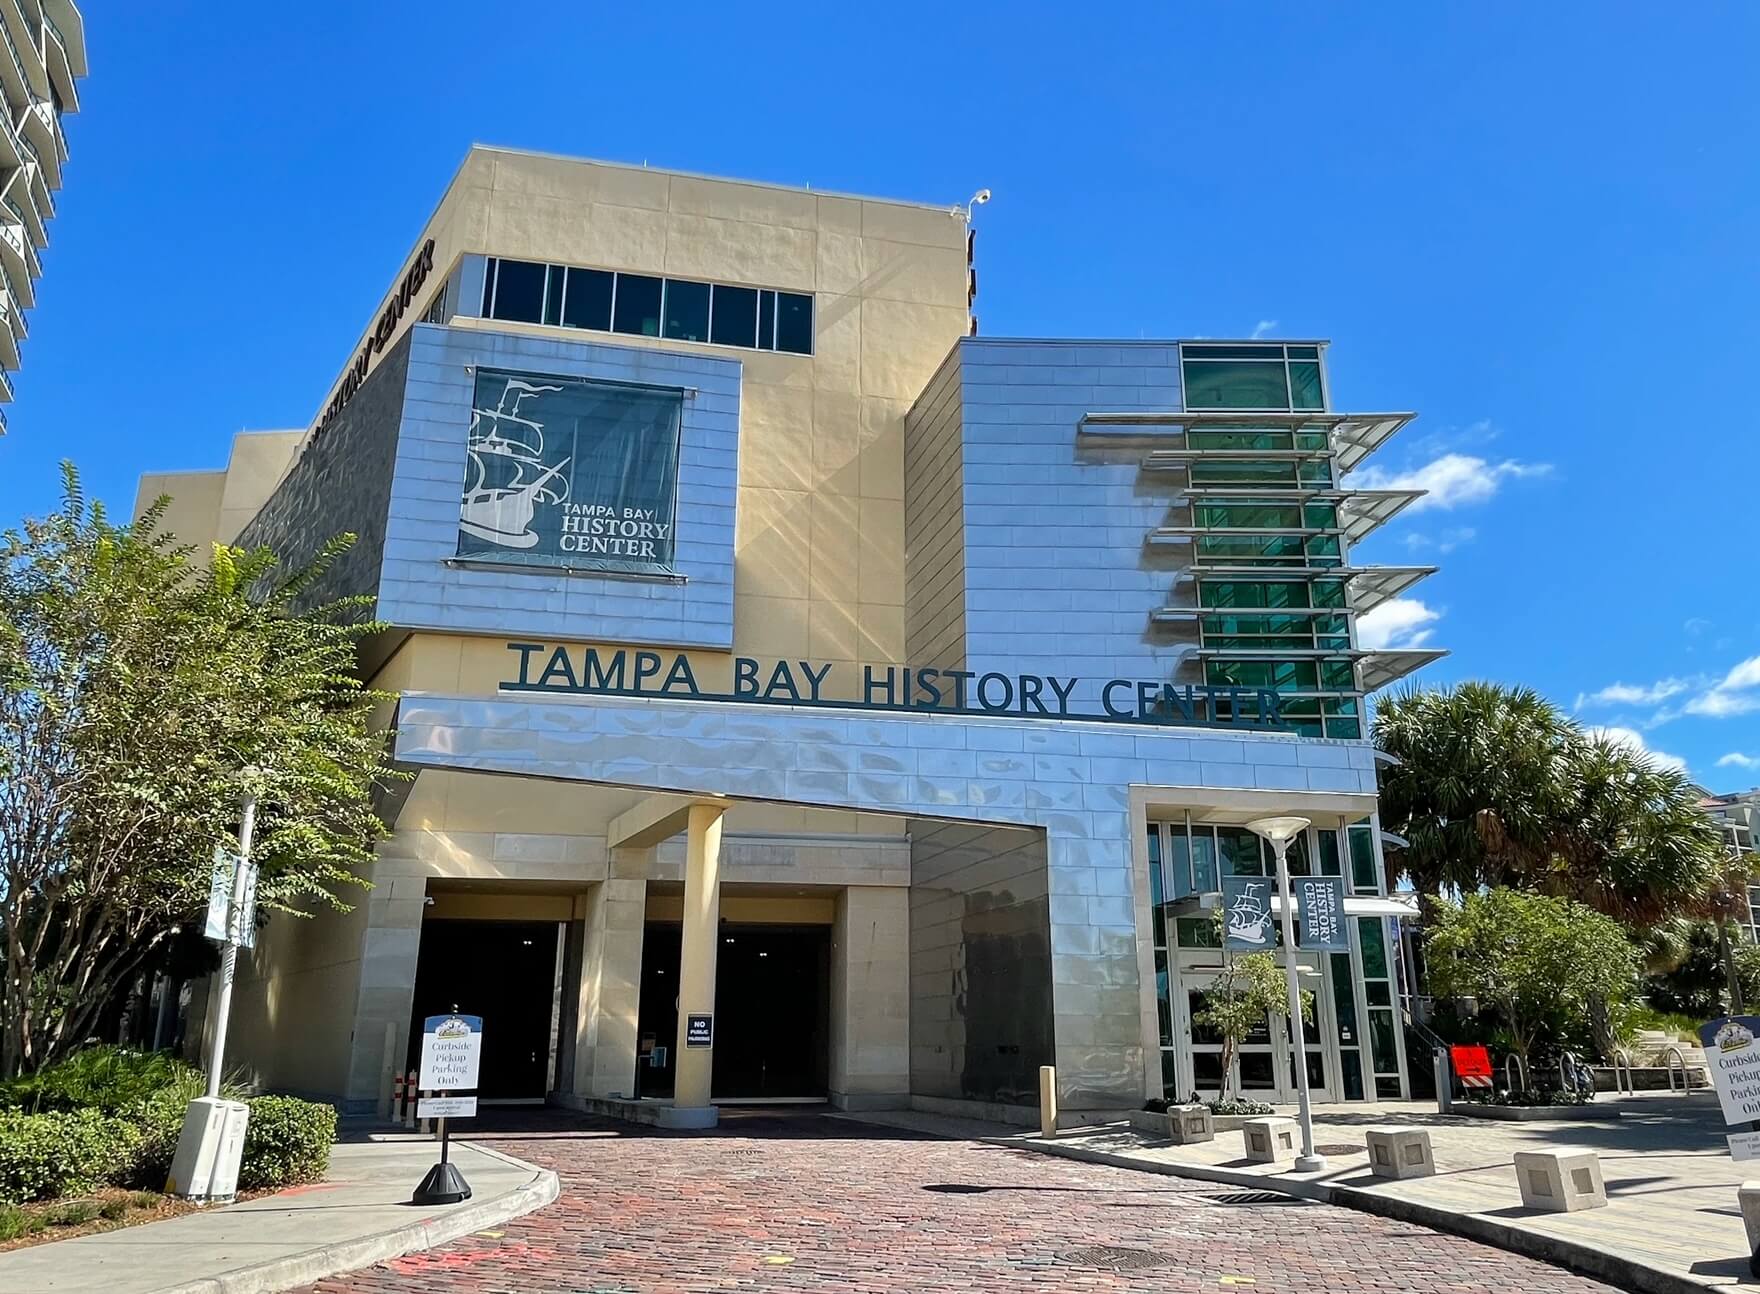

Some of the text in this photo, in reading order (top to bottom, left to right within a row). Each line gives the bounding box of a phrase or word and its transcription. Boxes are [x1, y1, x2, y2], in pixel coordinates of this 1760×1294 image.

[562, 503, 653, 520] TAMPA BAY
[561, 516, 669, 539] HISTORY
[560, 535, 656, 557] CENTER
[507, 643, 1286, 726] TAMPA BAY HISTORY CENTER
[1304, 883, 1319, 938] CENTER
[1315, 883, 1331, 944] HISTORY
[1326, 882, 1338, 935] TAMPA BAY
[432, 1042, 472, 1050] Curbside
[436, 1054, 466, 1063] Pickup
[432, 1064, 468, 1074] Parking
[438, 1076, 458, 1086] Only
[1730, 1085, 1760, 1100] Parki
[1743, 1101, 1760, 1114] Onl
